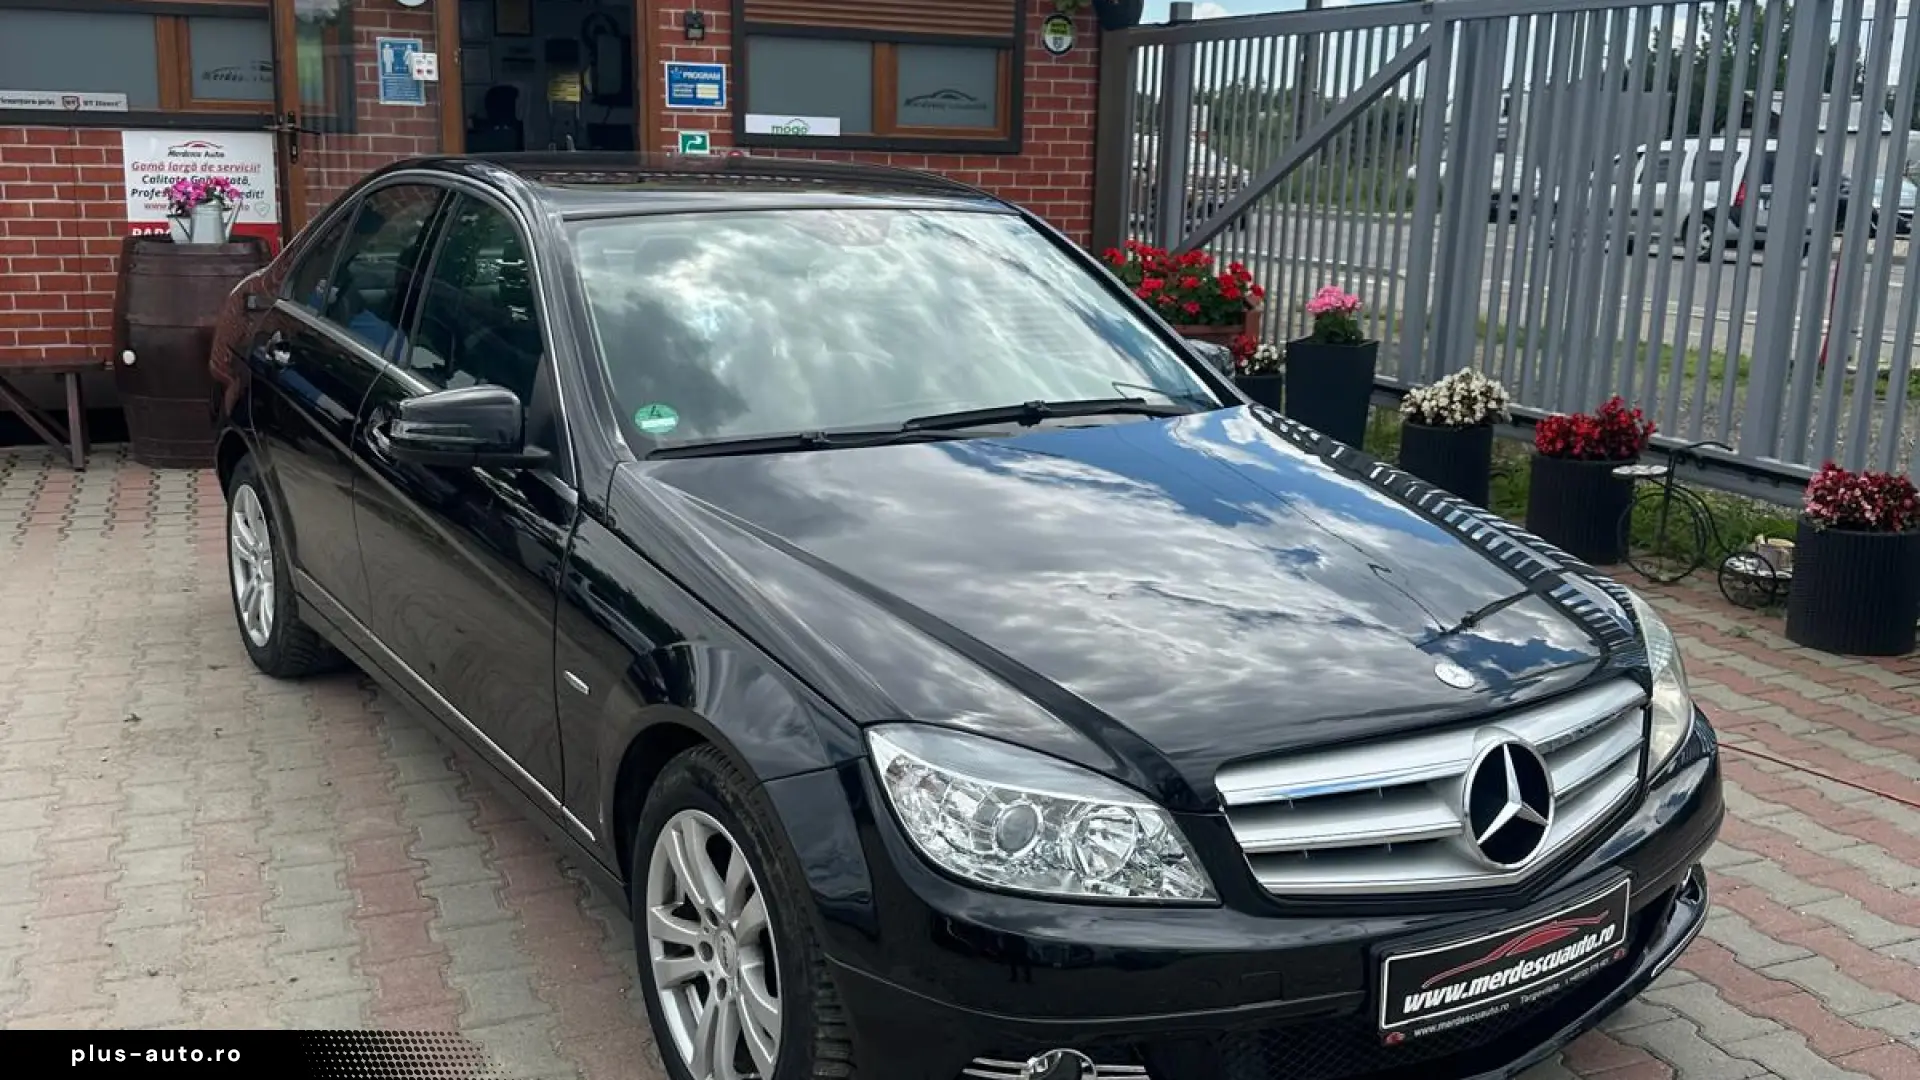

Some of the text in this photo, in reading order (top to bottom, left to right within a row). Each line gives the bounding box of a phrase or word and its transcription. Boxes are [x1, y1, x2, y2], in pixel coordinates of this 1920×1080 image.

[683, 71, 721, 80] PROGRAM
[201, 161, 214, 172] de
[1403, 923, 1616, 1014] www.merdescuauto.ro
[1413, 1002, 1510, 1037] www.merdescuauto.ro
